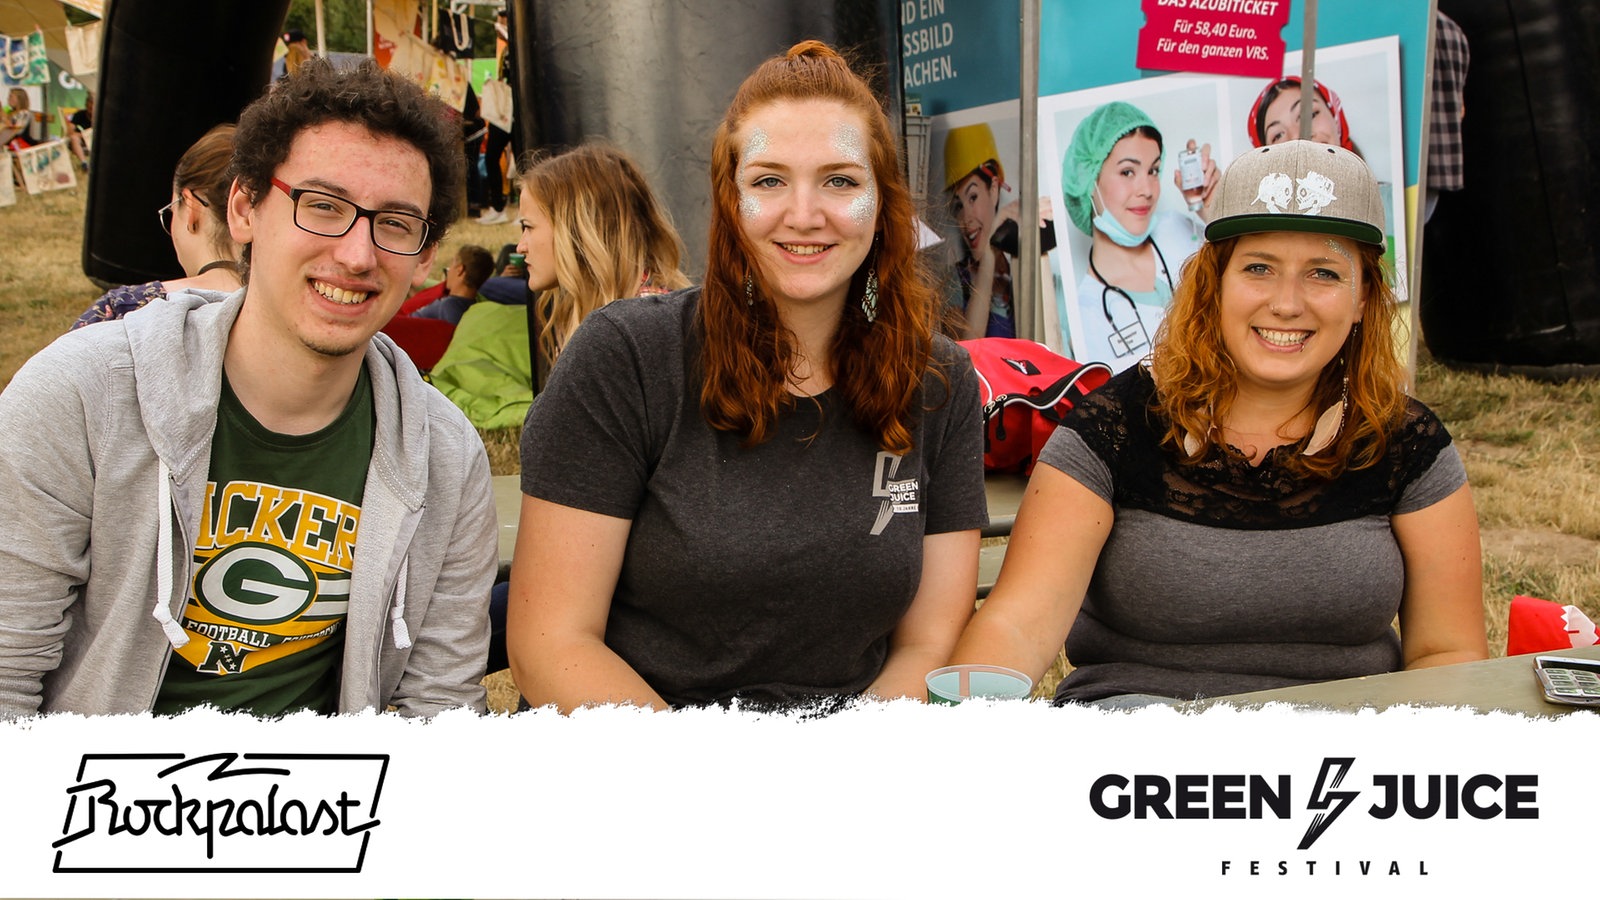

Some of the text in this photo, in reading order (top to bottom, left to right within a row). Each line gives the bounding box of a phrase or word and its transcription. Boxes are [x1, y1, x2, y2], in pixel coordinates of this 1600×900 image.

[920, 0, 945, 20] EIN
[1189, 0, 1279, 16] AZUBITICKET
[903, 22, 954, 57] SSBILD
[1173, 19, 1258, 40] Für 58,40 Euro.
[1156, 37, 1270, 61] Für den ganzen VRS.
[904, 55, 957, 89] ACHEN.
[888, 481, 919, 493] GREEN
[889, 491, 916, 502] JUICE
[201, 546, 311, 621] G
[186, 620, 271, 648] FOOTBALL
